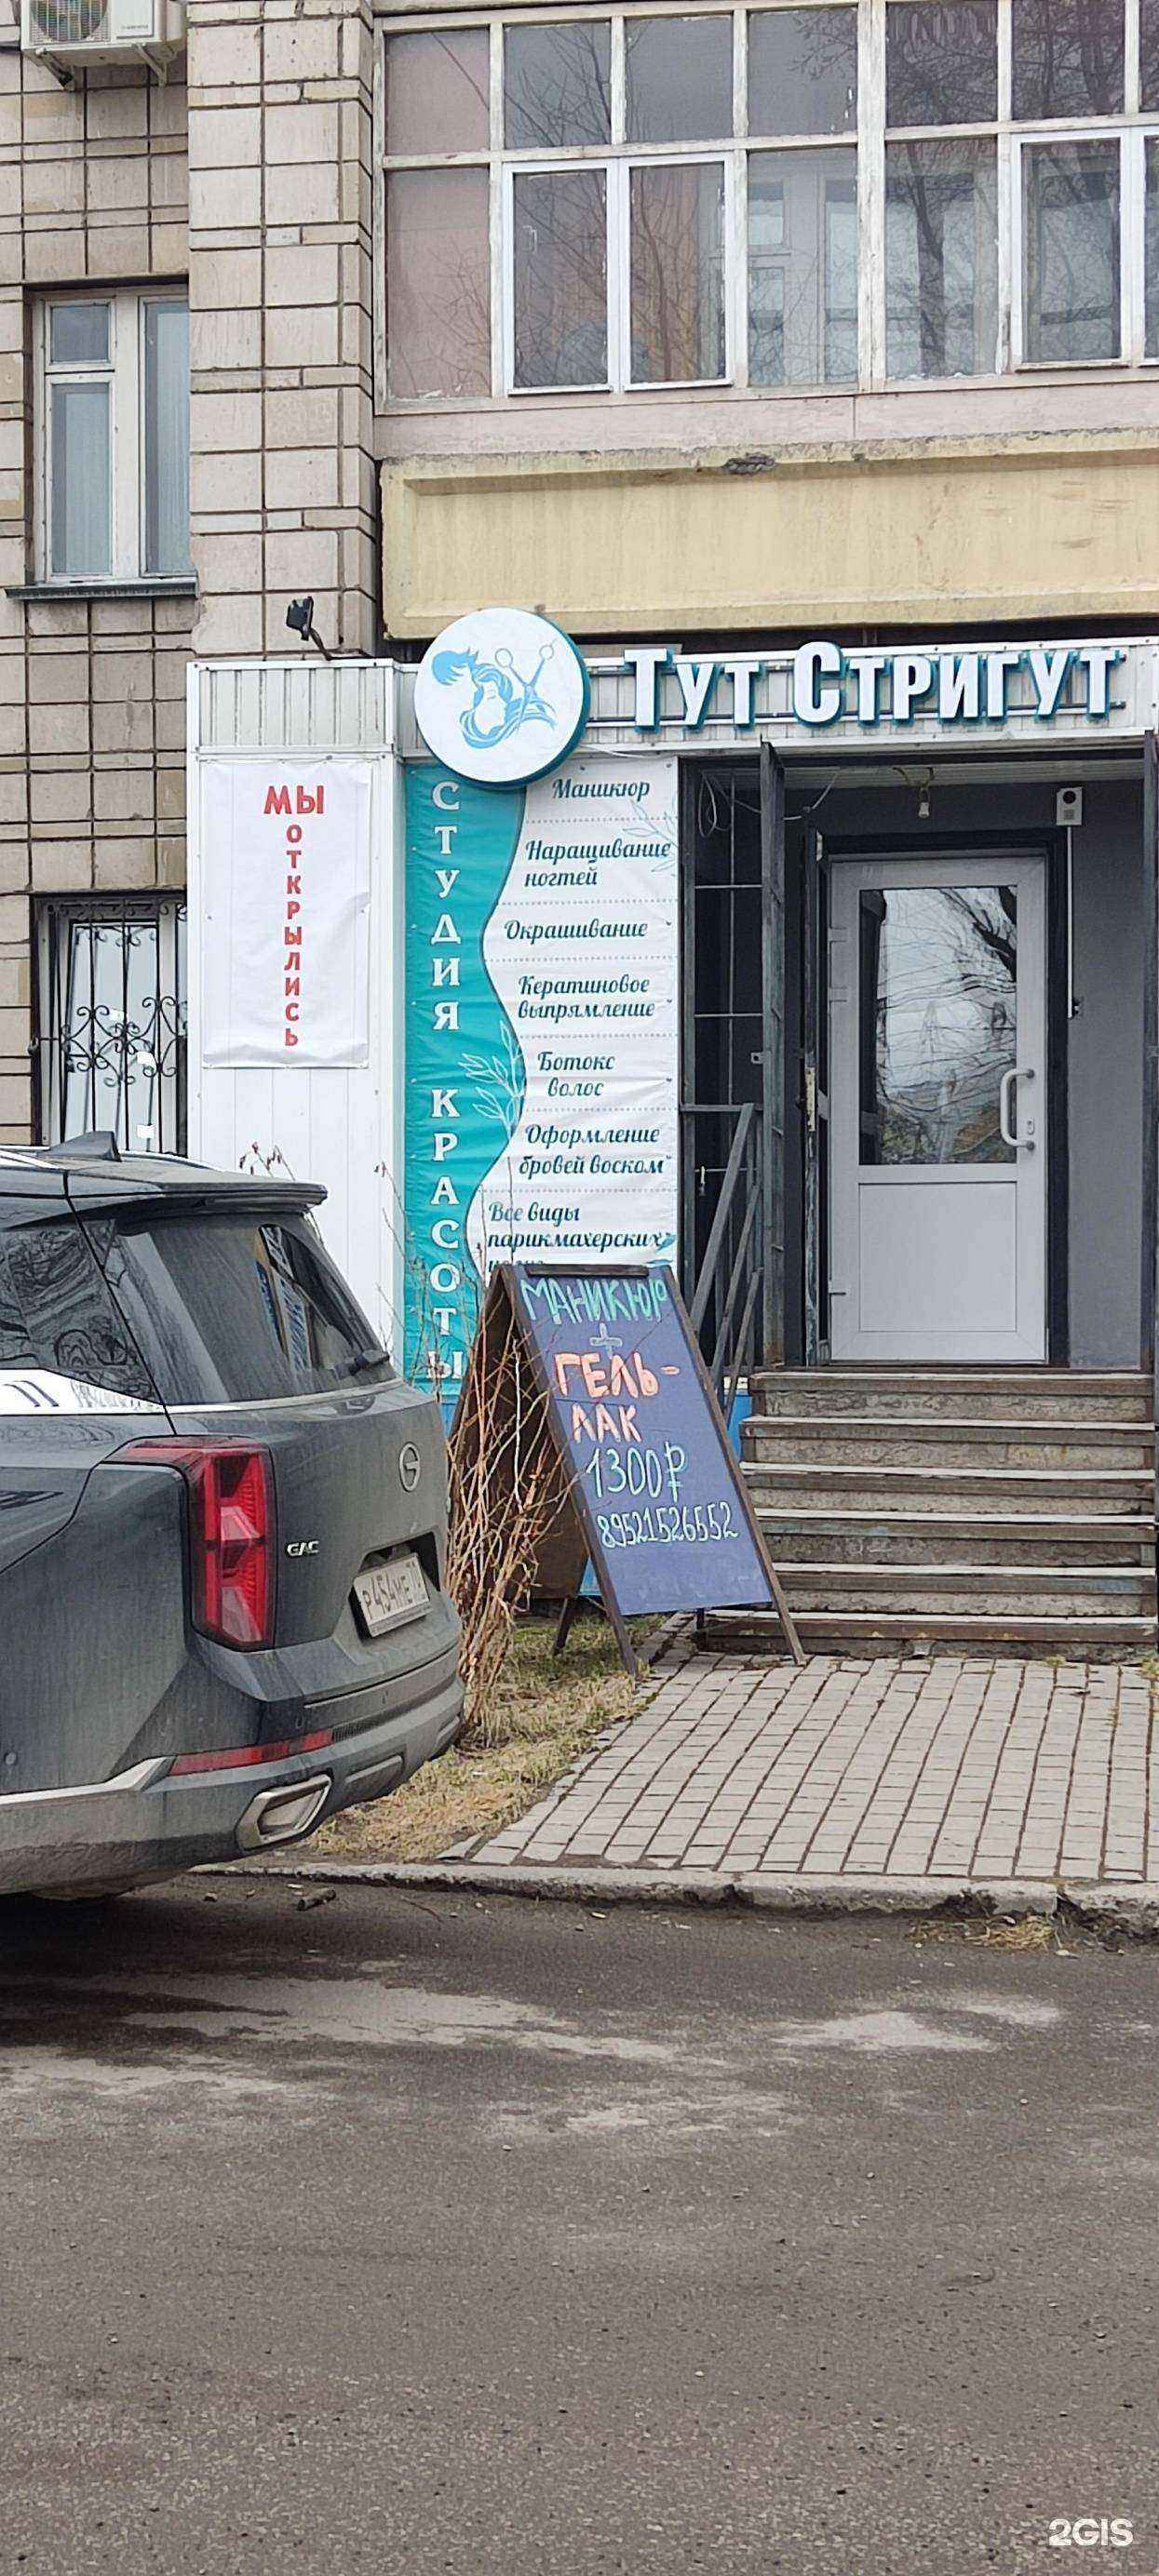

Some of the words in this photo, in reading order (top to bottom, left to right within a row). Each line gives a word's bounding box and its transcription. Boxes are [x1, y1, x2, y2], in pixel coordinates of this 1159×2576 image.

[263, 785, 324, 814] МЫ
[551, 778, 651, 802] Маникюр
[525, 838, 671, 865] Наращивание
[524, 866, 599, 888] ногтей
[431, 781, 462, 1031] СТУДИЯ
[283, 824, 303, 1047] ОТКРЫЛИСЬ
[504, 918, 649, 945] Окрашивание
[518, 973, 651, 1000] Кератиновое
[518, 1000, 655, 1024] выпрямление
[537, 1051, 616, 1071] Ботокс
[547, 1077, 604, 1096] волос
[525, 1123, 661, 1149] Оформление
[519, 1155, 585, 1180] бровей
[589, 1154, 664, 1174] воском
[488, 1201, 524, 1222] Все
[527, 1201, 581, 1228] виды
[428, 1088, 464, 1381] КРАСОТЫ
[487, 1231, 663, 1254] парикмахерских
[519, 1278, 668, 1325] МАНИКЮР
[554, 1351, 681, 1399] ГЕЛЬ-
[572, 1402, 642, 1443] ЛАК
[597, 1501, 738, 1549] 89521526552
[287, 1540, 319, 1556] GAC
